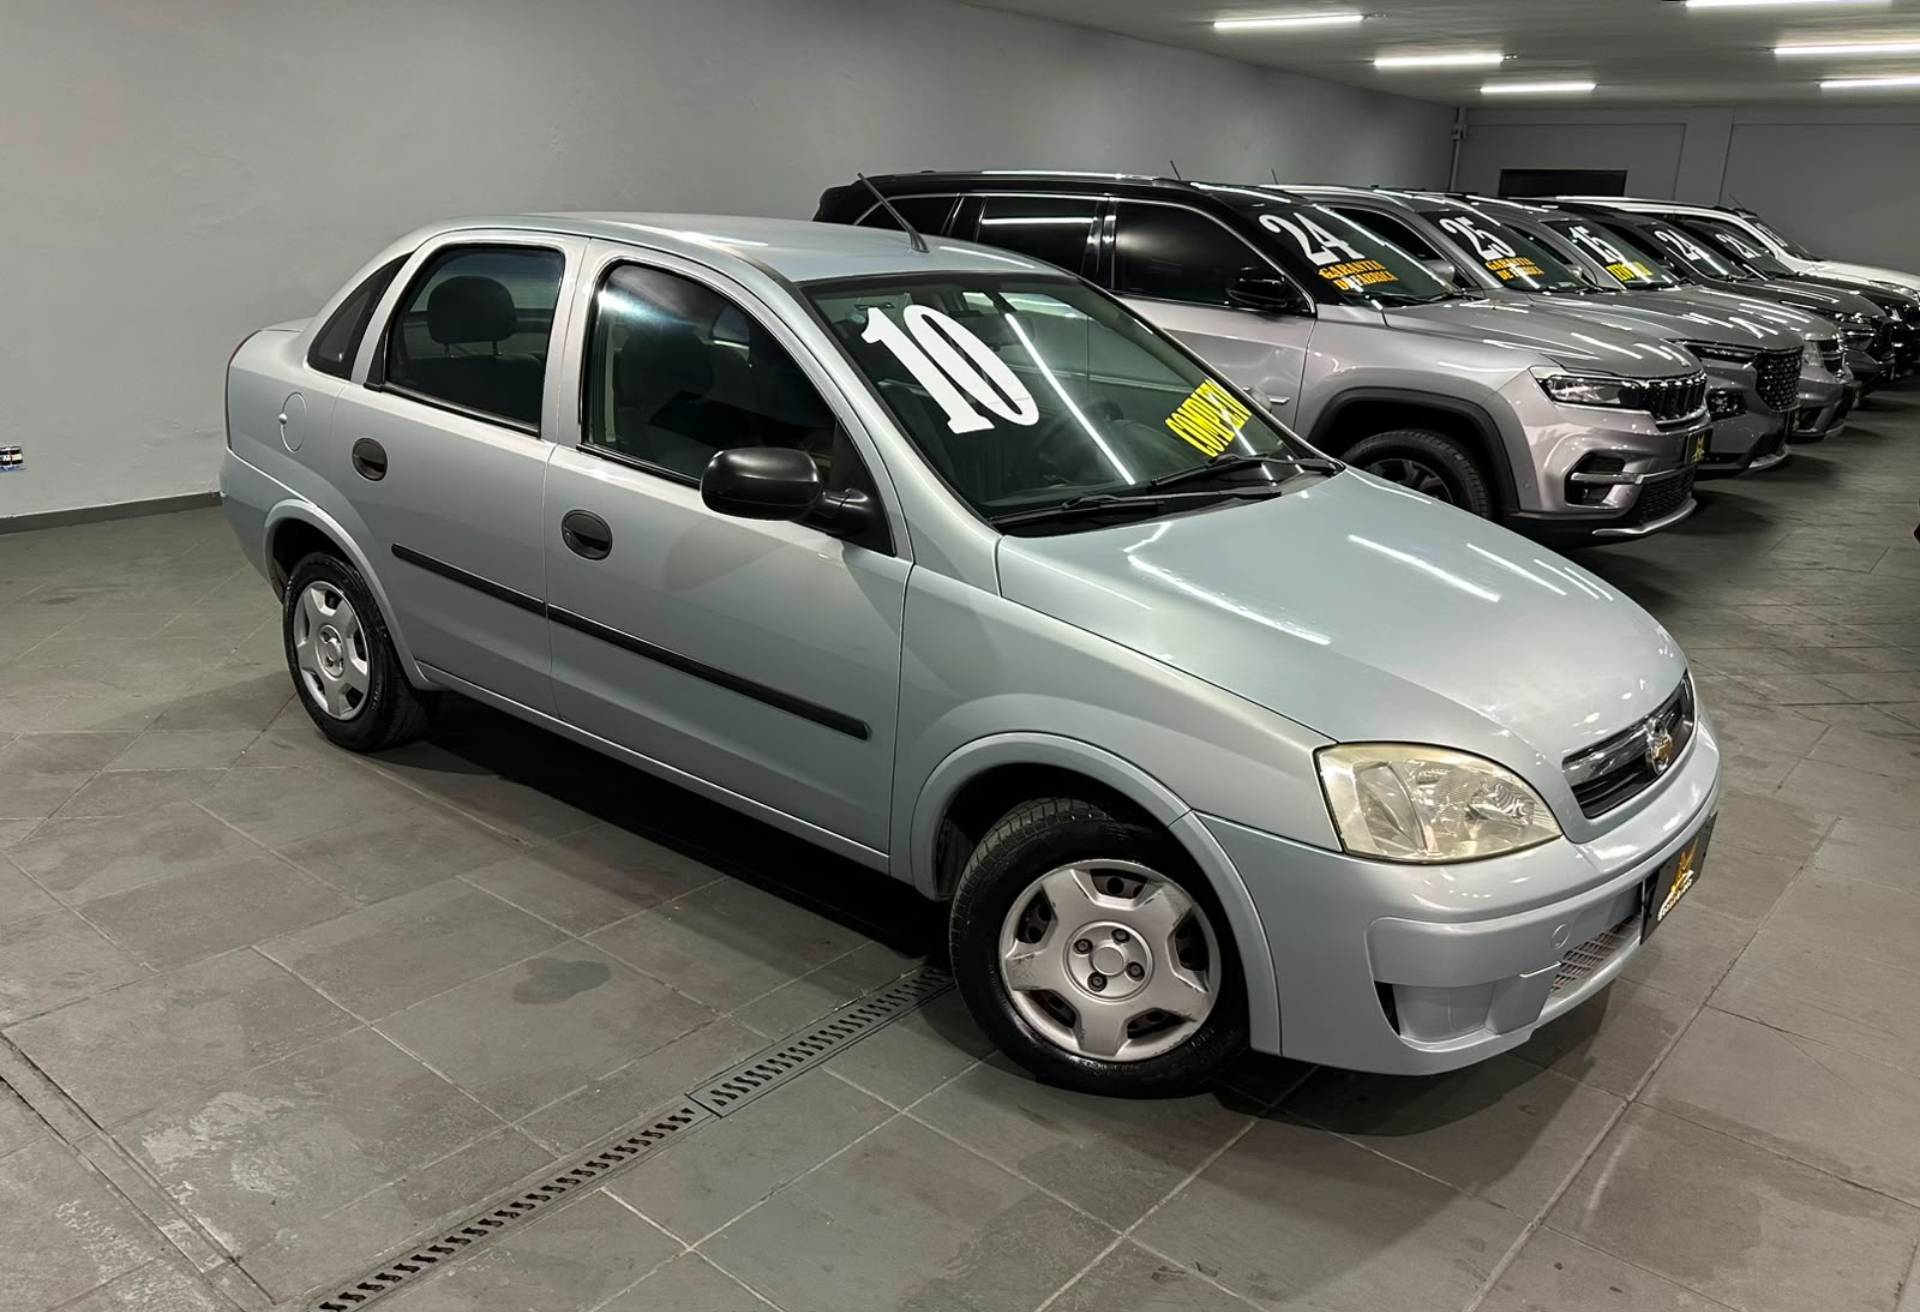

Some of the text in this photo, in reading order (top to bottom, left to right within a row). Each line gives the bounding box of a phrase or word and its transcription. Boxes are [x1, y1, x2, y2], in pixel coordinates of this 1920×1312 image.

[1259, 212, 1366, 266] 24
[1440, 216, 1517, 261] 25
[1569, 226, 1625, 263] 15
[1654, 229, 1710, 261] 24
[1318, 260, 1387, 279] GARANTIA
[861, 304, 1040, 434] 10
[1165, 377, 1253, 457] COMPLETO
